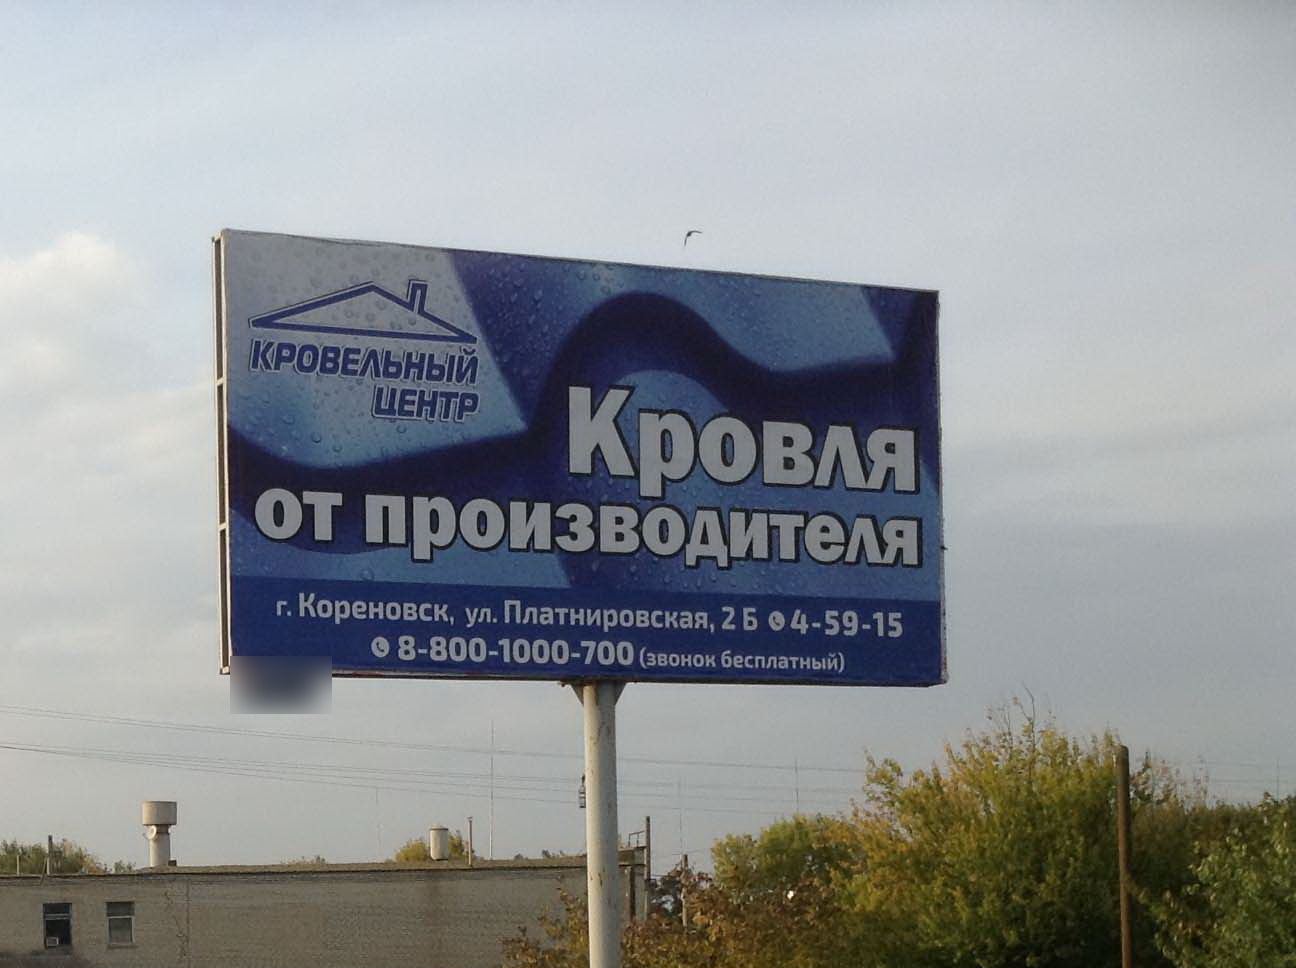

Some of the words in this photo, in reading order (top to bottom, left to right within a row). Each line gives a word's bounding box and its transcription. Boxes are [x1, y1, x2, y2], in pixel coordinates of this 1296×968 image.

[250, 338, 479, 384] КРОВЕЛЬНЫЙ
[372, 385, 480, 422] ЦЕНТР
[567, 385, 917, 499] Кровля
[254, 487, 344, 542] от
[364, 493, 920, 568] производителя
[275, 600, 292, 617] г.
[298, 592, 455, 626] Кореновск,
[465, 605, 498, 628] ул.
[503, 599, 715, 633] Платнировская,
[790, 609, 904, 638] 4-59-15
[397, 635, 635, 666] 8-800-1000-700
[639, 647, 717, 669] (звонок
[720, 650, 846, 673] бесплатный)
